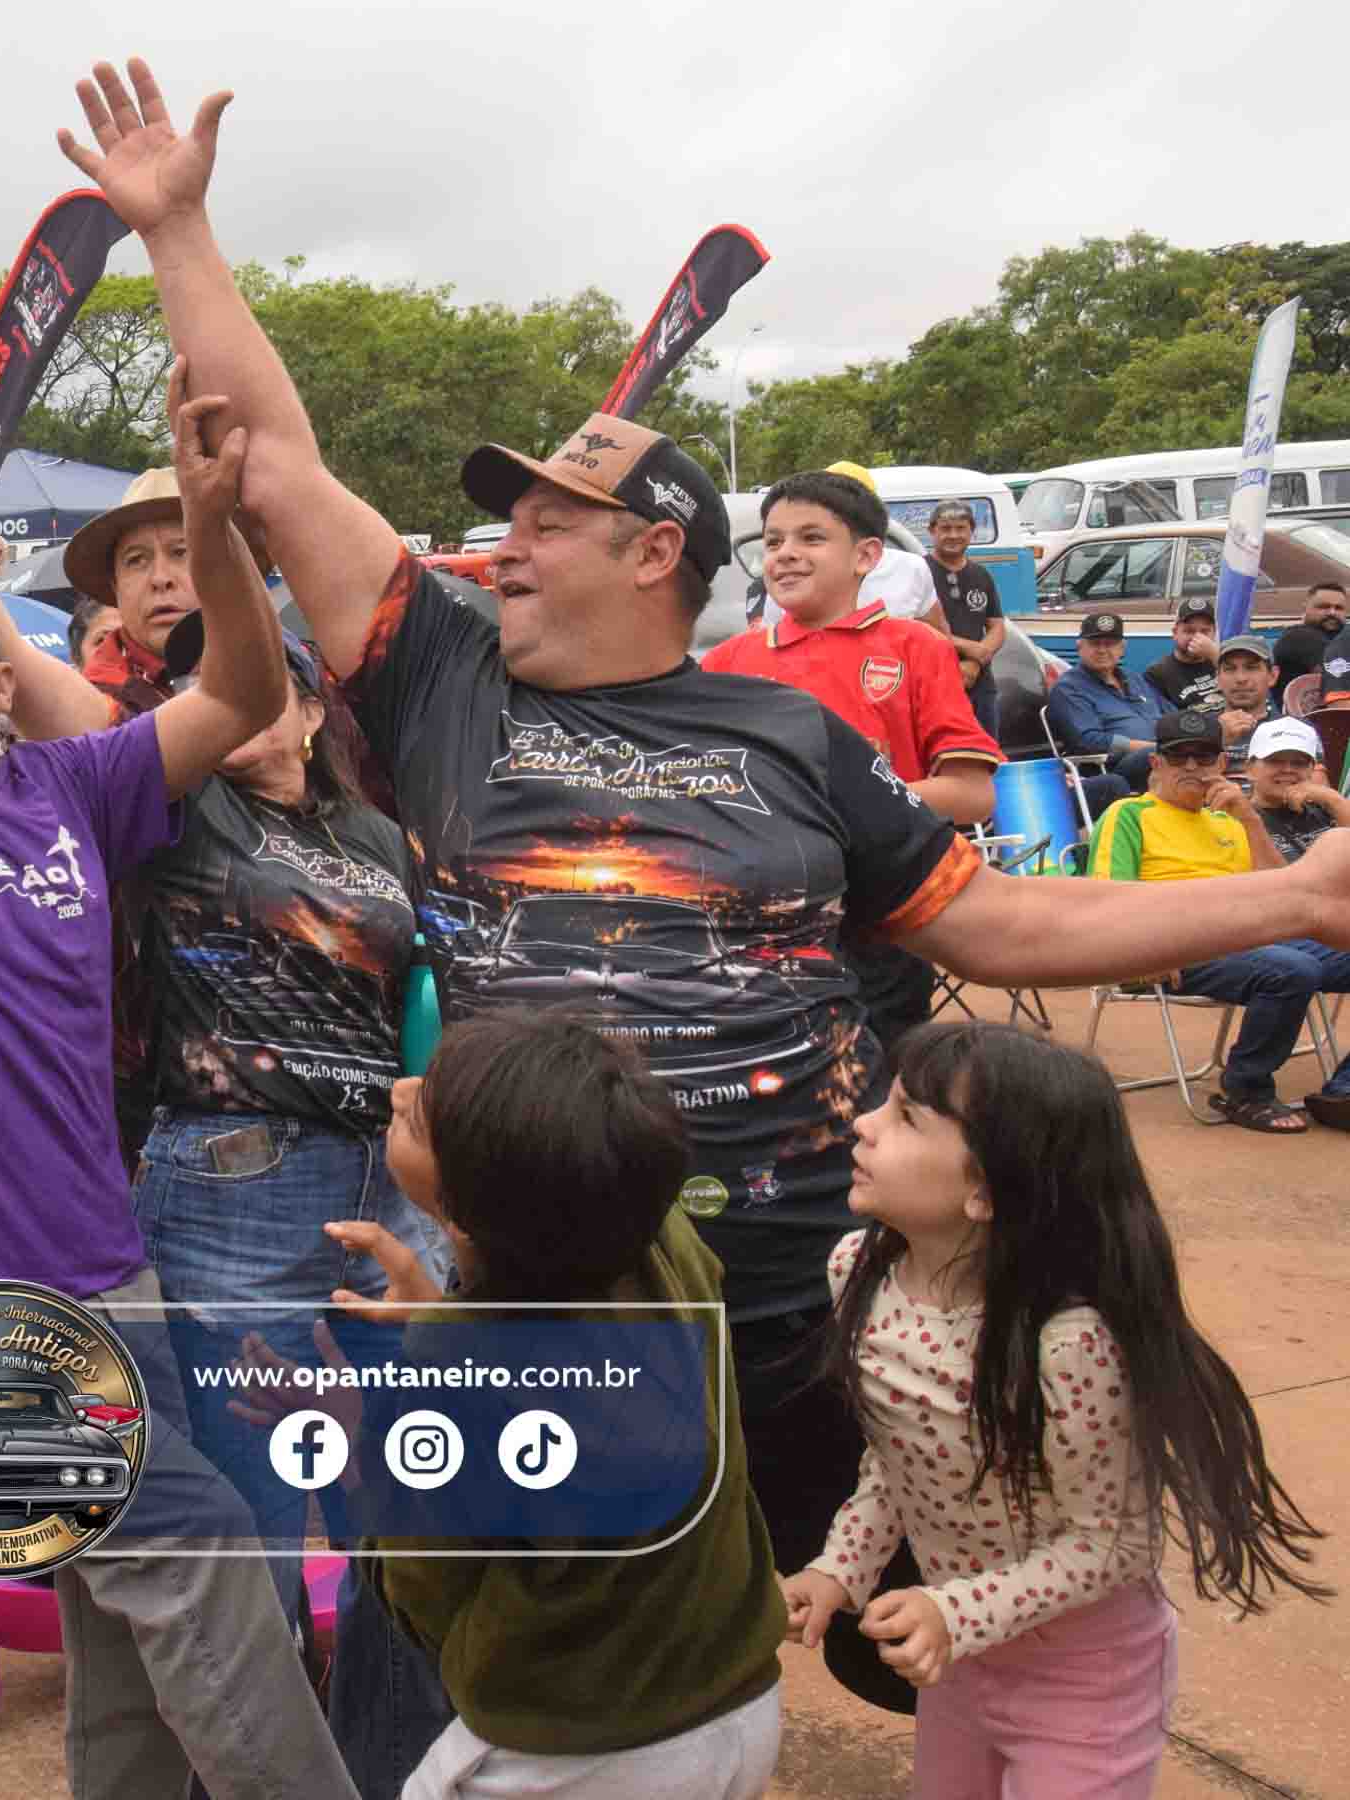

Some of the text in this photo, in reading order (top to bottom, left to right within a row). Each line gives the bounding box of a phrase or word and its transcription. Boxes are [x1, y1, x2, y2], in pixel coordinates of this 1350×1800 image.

[669, 482, 698, 511] MEVO
[282, 1059, 331, 1081] EDIÇÃO
[668, 1082, 751, 1109] RATIVA
